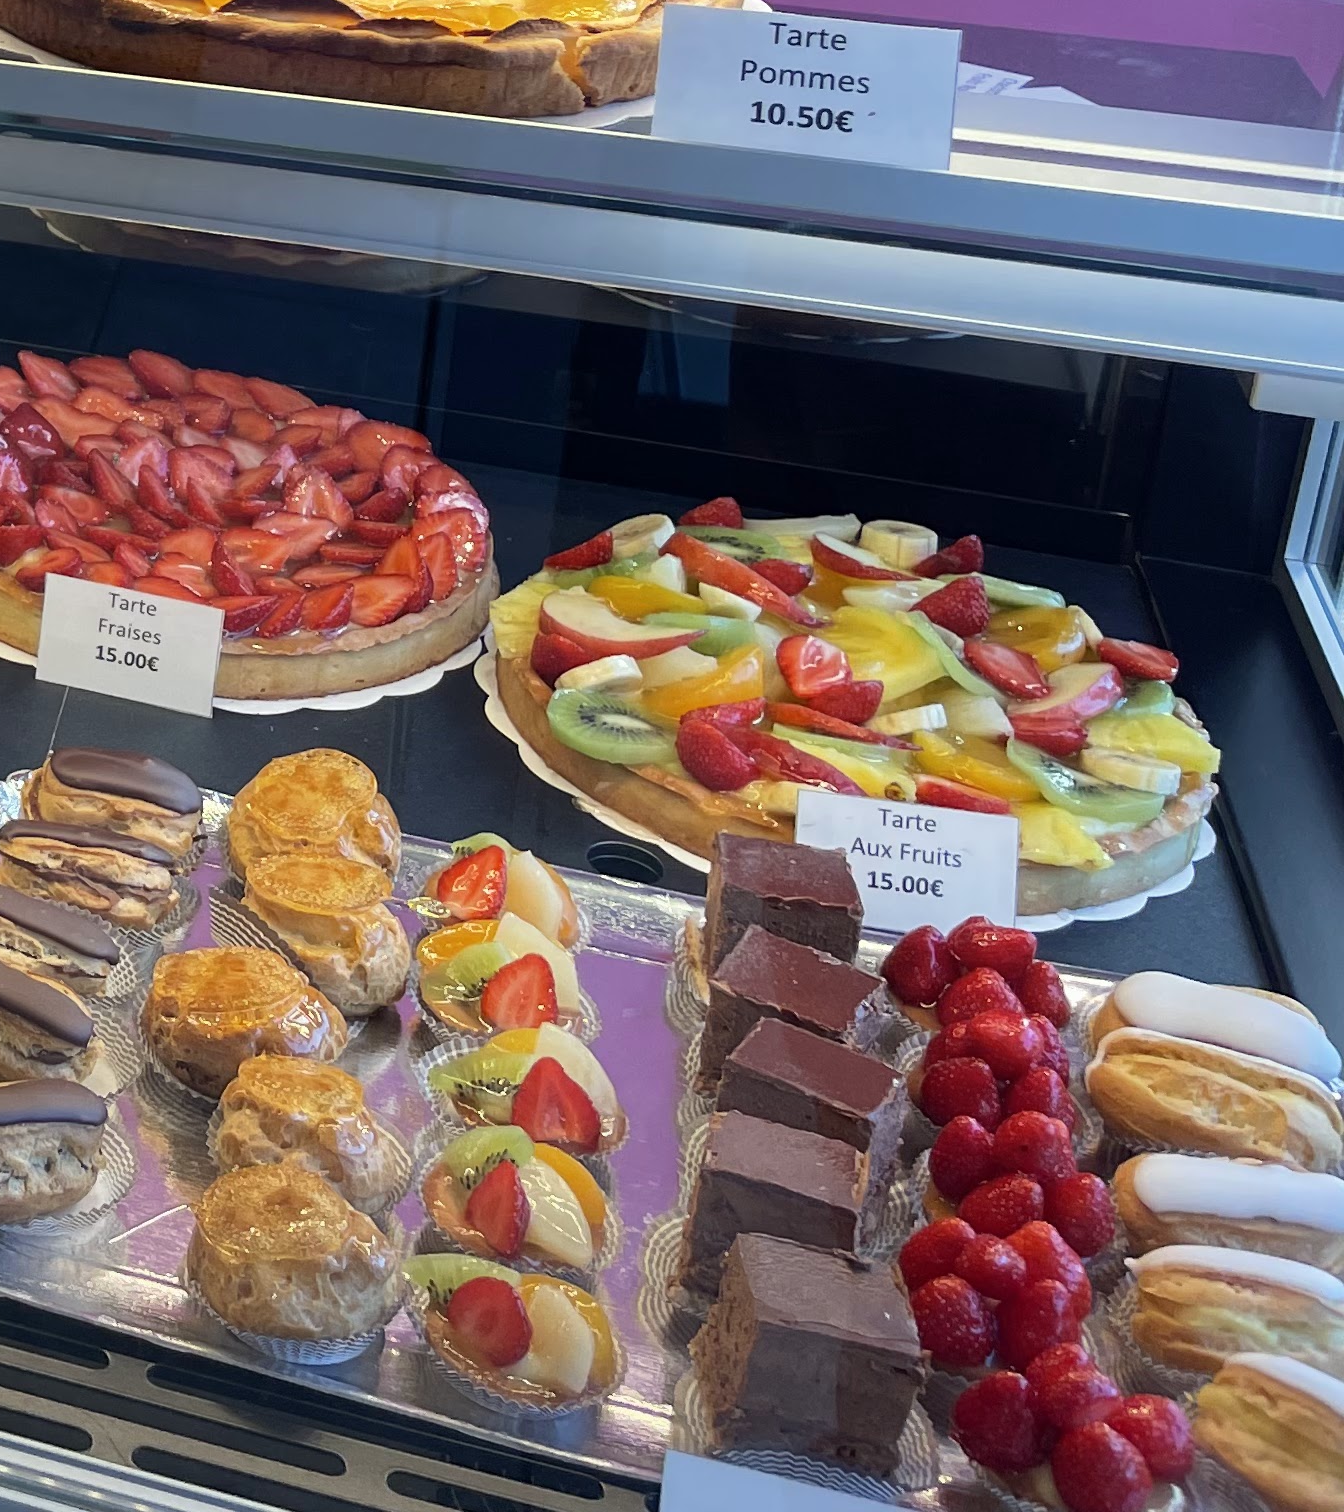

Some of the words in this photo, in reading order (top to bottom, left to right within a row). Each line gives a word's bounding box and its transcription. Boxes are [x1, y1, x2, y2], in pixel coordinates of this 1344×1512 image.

[768, 22, 848, 51] Tarte
[740, 59, 870, 94] Pommes
[750, 101, 854, 133] 10.50€
[109, 591, 157, 617] Tarte
[98, 618, 162, 646] Fraises
[95, 645, 160, 673] 15.00€
[878, 808, 937, 833] Tarte
[850, 837, 893, 860] Aux
[900, 842, 963, 869] Fruits
[867, 871, 945, 898] 15.00€
